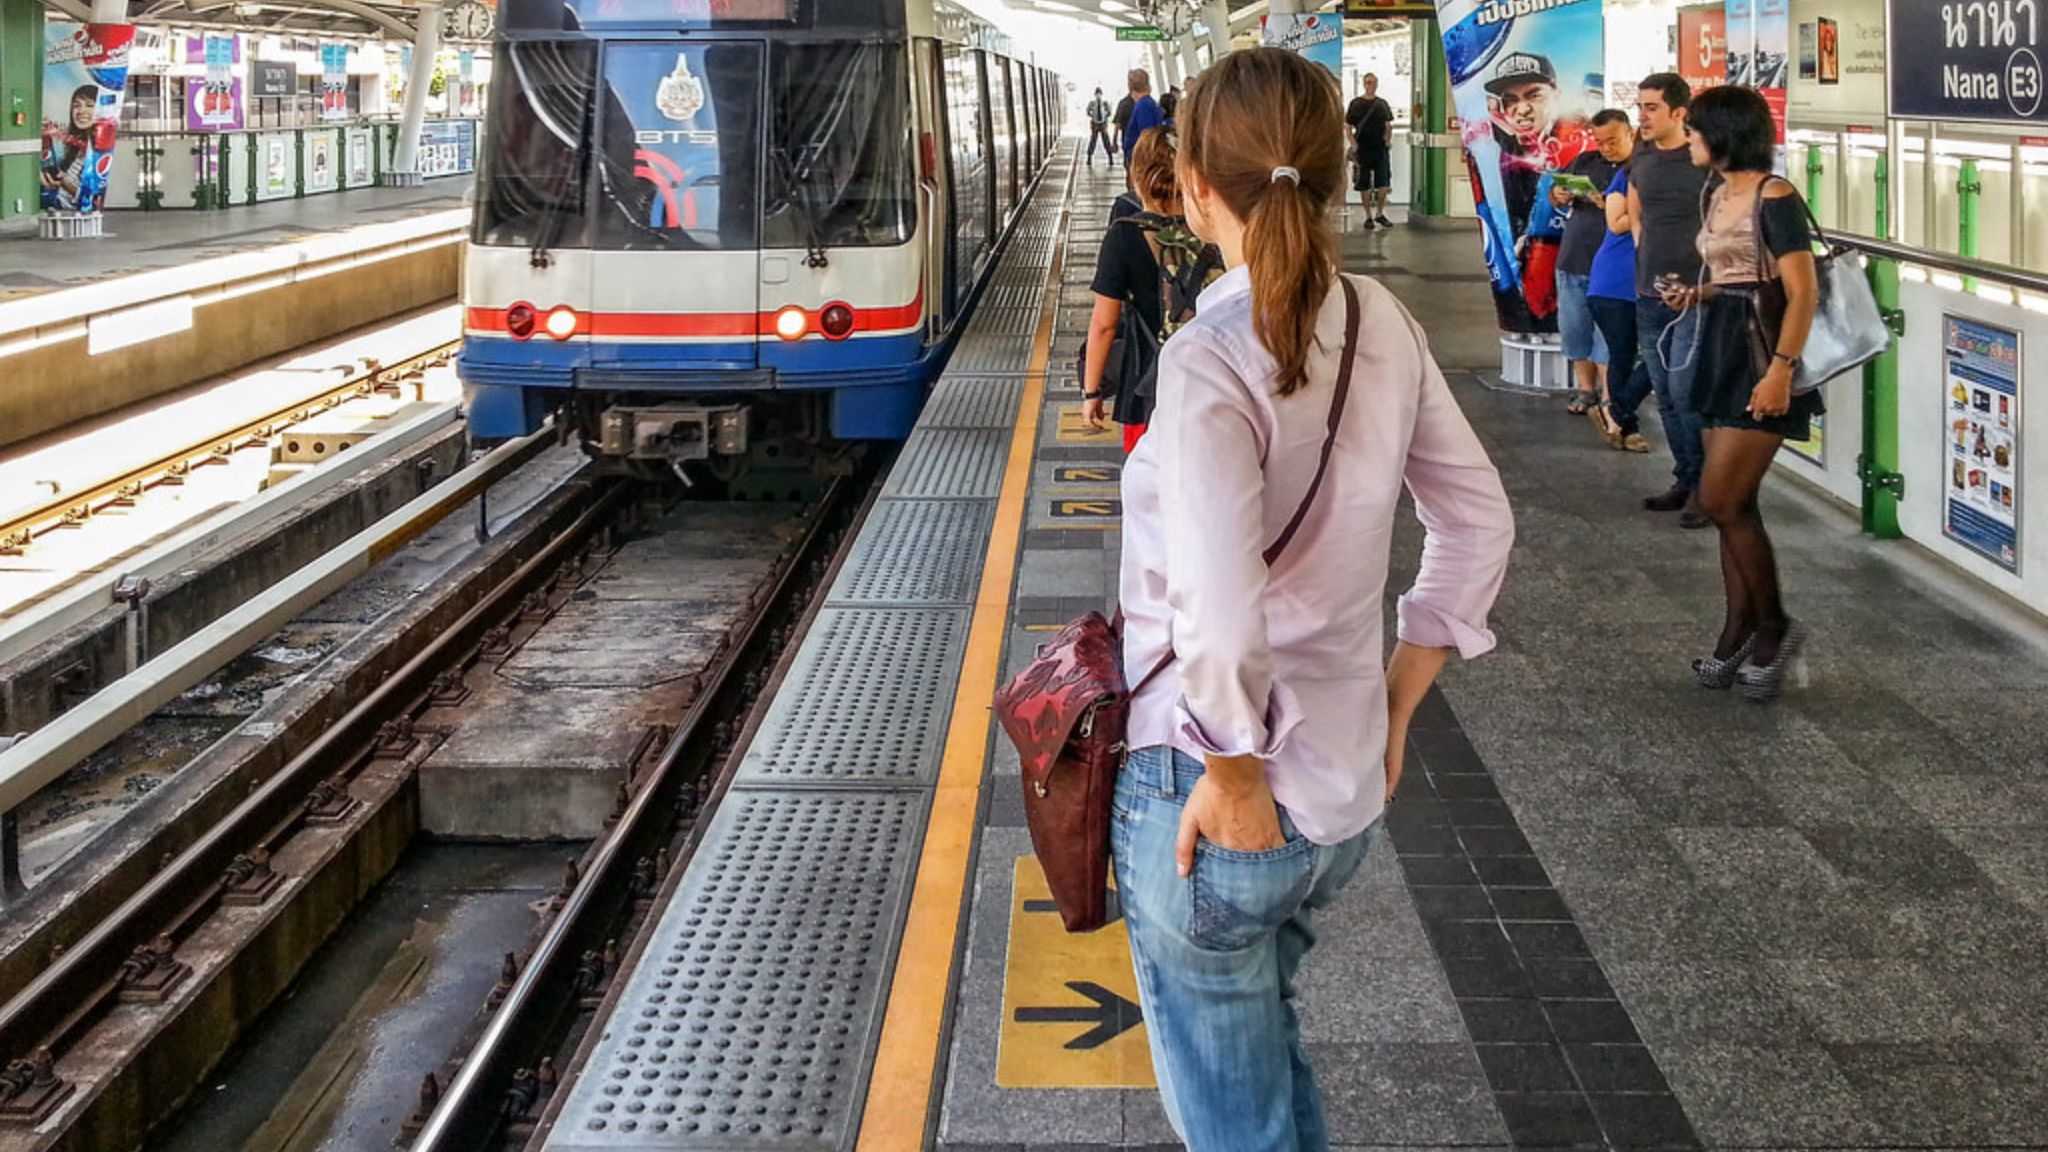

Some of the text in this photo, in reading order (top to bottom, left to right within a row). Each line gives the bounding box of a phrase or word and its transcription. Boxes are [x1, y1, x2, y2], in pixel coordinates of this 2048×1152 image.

[1942, 0, 2036, 47] นานา
[1700, 24, 1711, 68] 5
[1943, 65, 2038, 99] Nana E3
[635, 131, 718, 144] BTS
